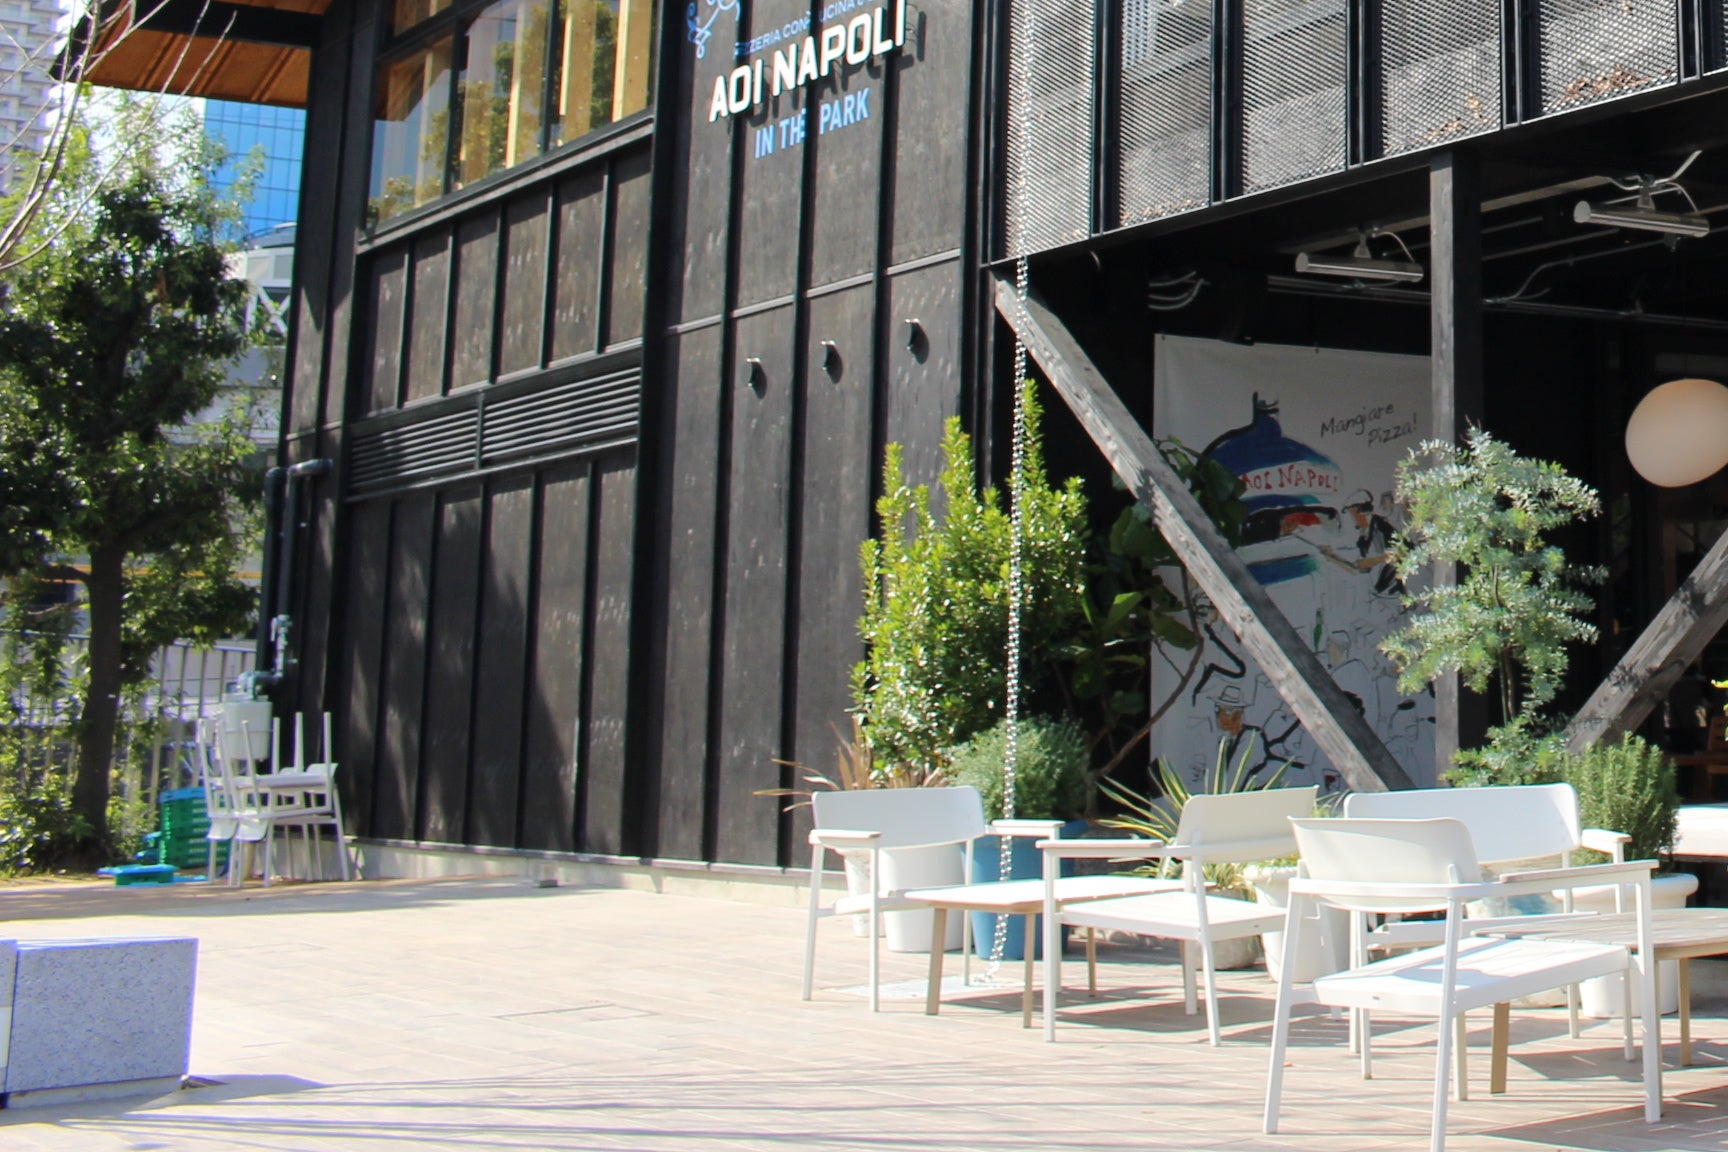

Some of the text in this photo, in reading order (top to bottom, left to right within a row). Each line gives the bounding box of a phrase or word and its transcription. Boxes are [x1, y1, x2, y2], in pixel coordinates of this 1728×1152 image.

[709, 58, 762, 121] AOI
[755, 88, 871, 158] IN THE PARK
[1320, 404, 1395, 438] Mangiare
[1367, 413, 1417, 447] Pizza!
[1277, 464, 1338, 492] NAPOLI
